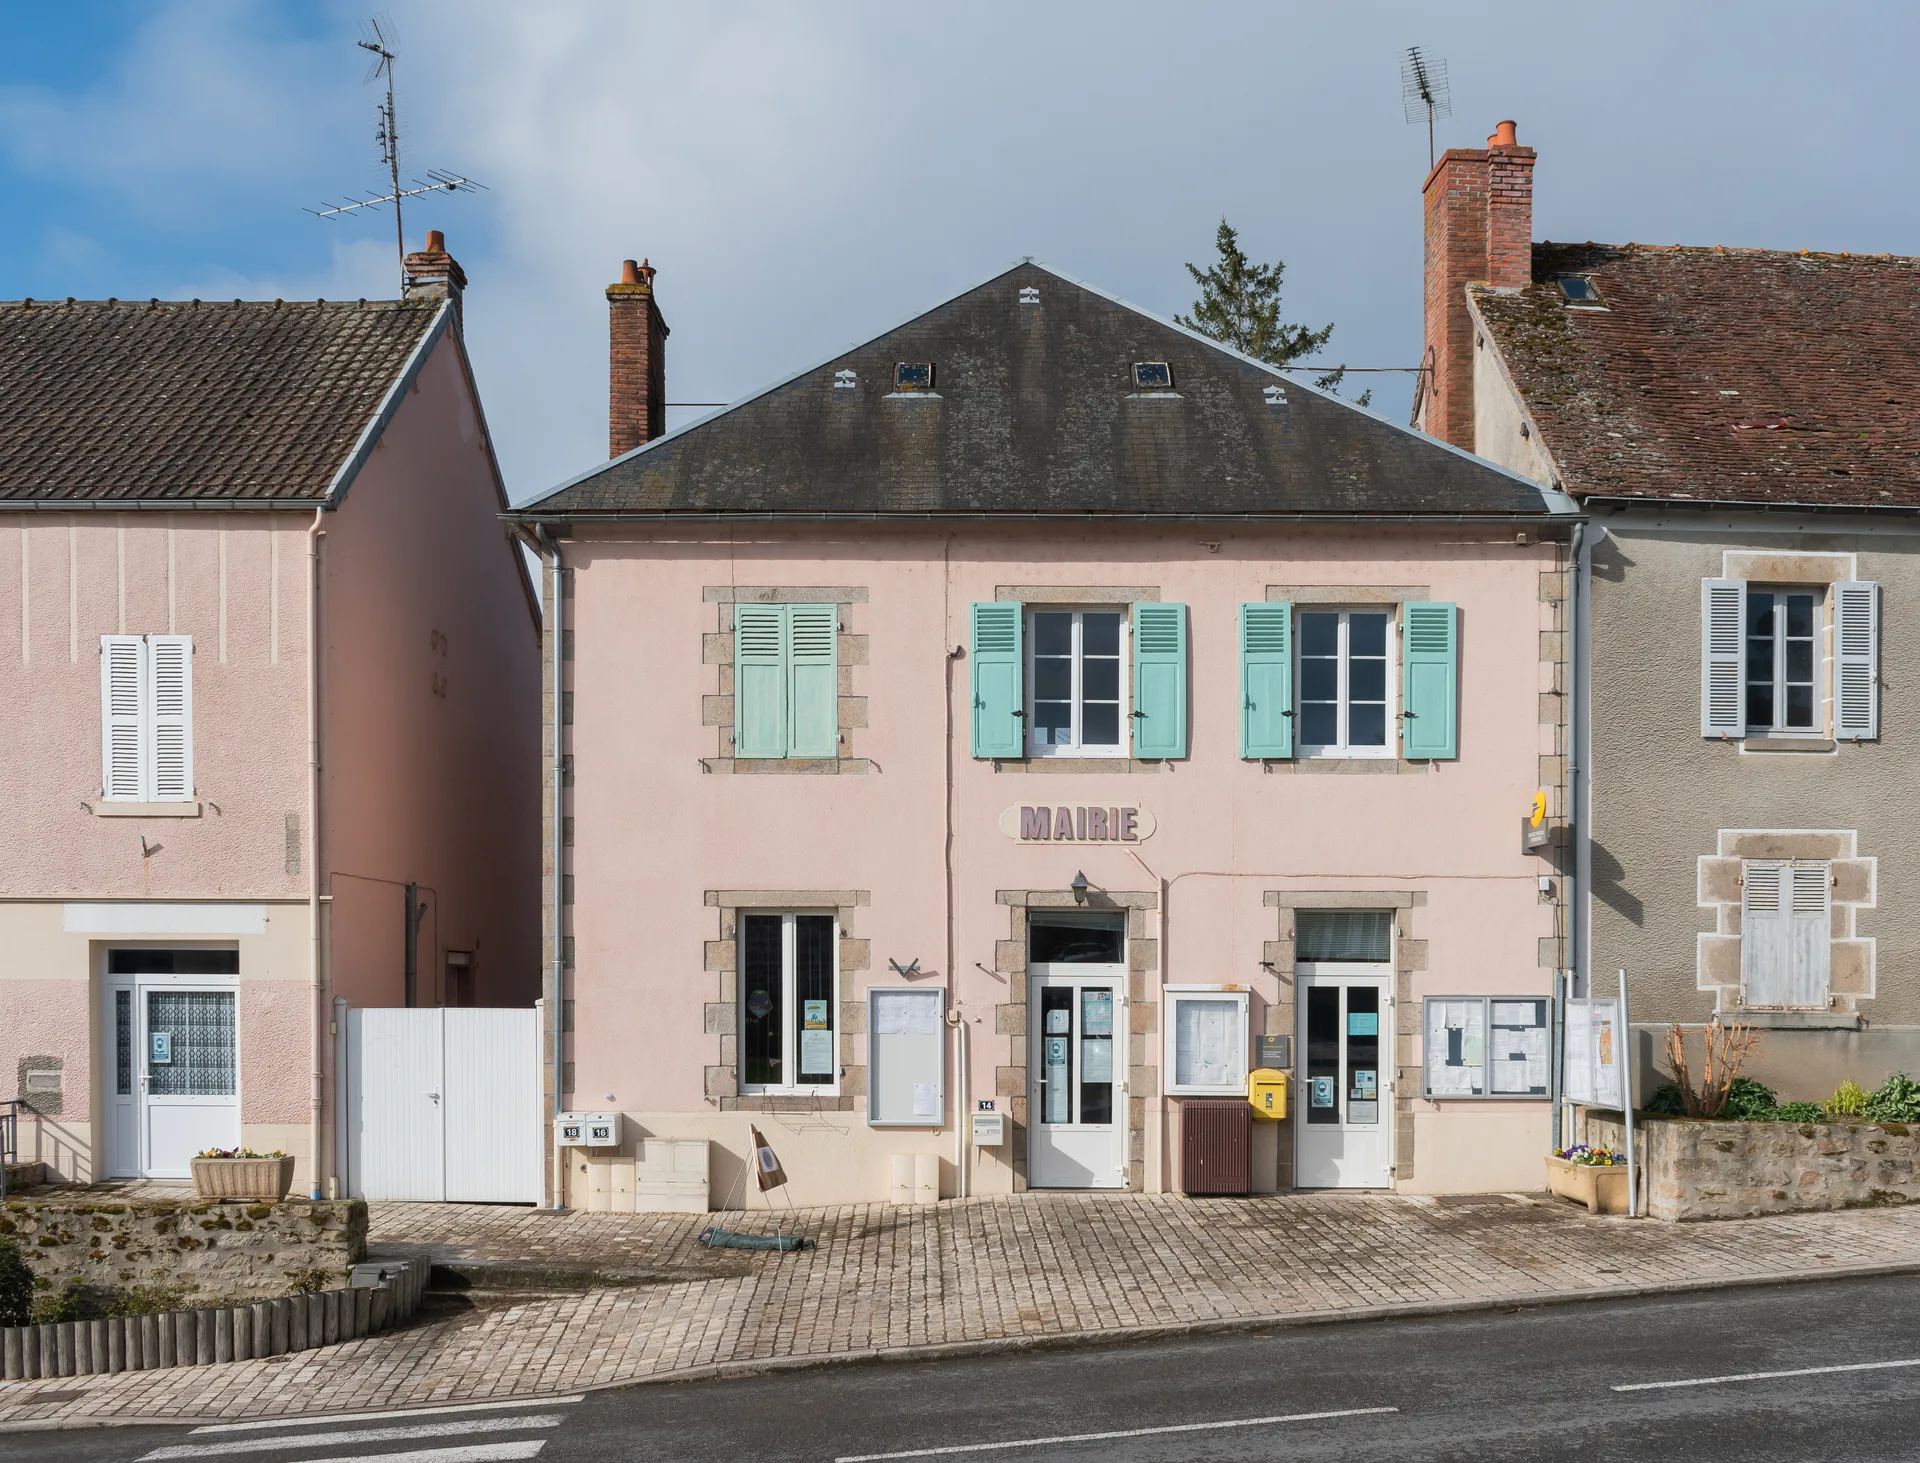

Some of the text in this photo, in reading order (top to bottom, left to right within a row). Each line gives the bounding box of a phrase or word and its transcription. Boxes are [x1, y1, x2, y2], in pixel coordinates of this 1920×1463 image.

[1020, 806, 1138, 841] MAIRIE
[981, 1101, 992, 1110] 14
[566, 1128, 577, 1136] 18
[595, 1128, 606, 1137] 16
